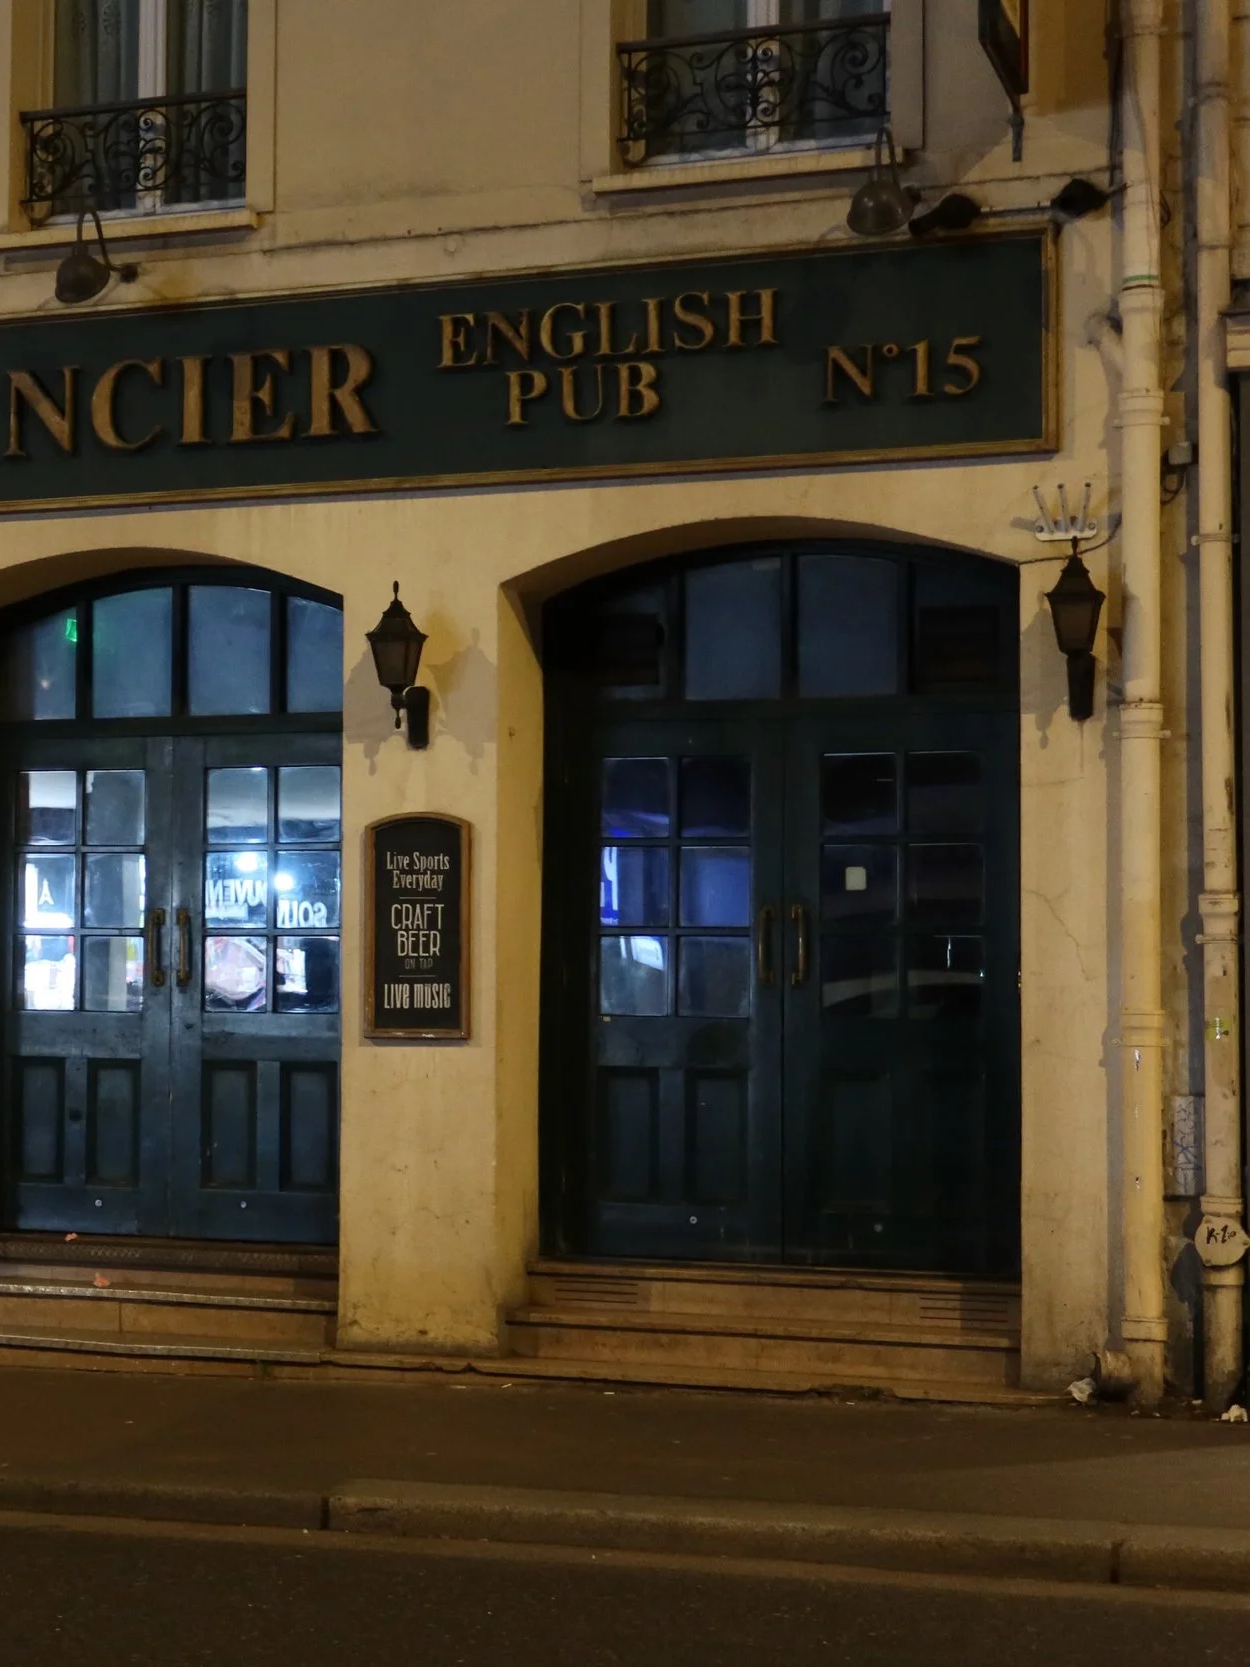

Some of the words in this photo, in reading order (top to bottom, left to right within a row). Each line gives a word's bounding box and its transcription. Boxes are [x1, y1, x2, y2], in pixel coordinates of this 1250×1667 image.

[436, 287, 779, 369] ENGLISH
[503, 360, 662, 426] PUB
[386, 852, 409, 870] Live
[413, 852, 450, 874] Sports
[392, 871, 444, 892] Everyday
[391, 904, 444, 930] CRAFT
[397, 930, 441, 957] BEER
[405, 958, 416, 970] ON
